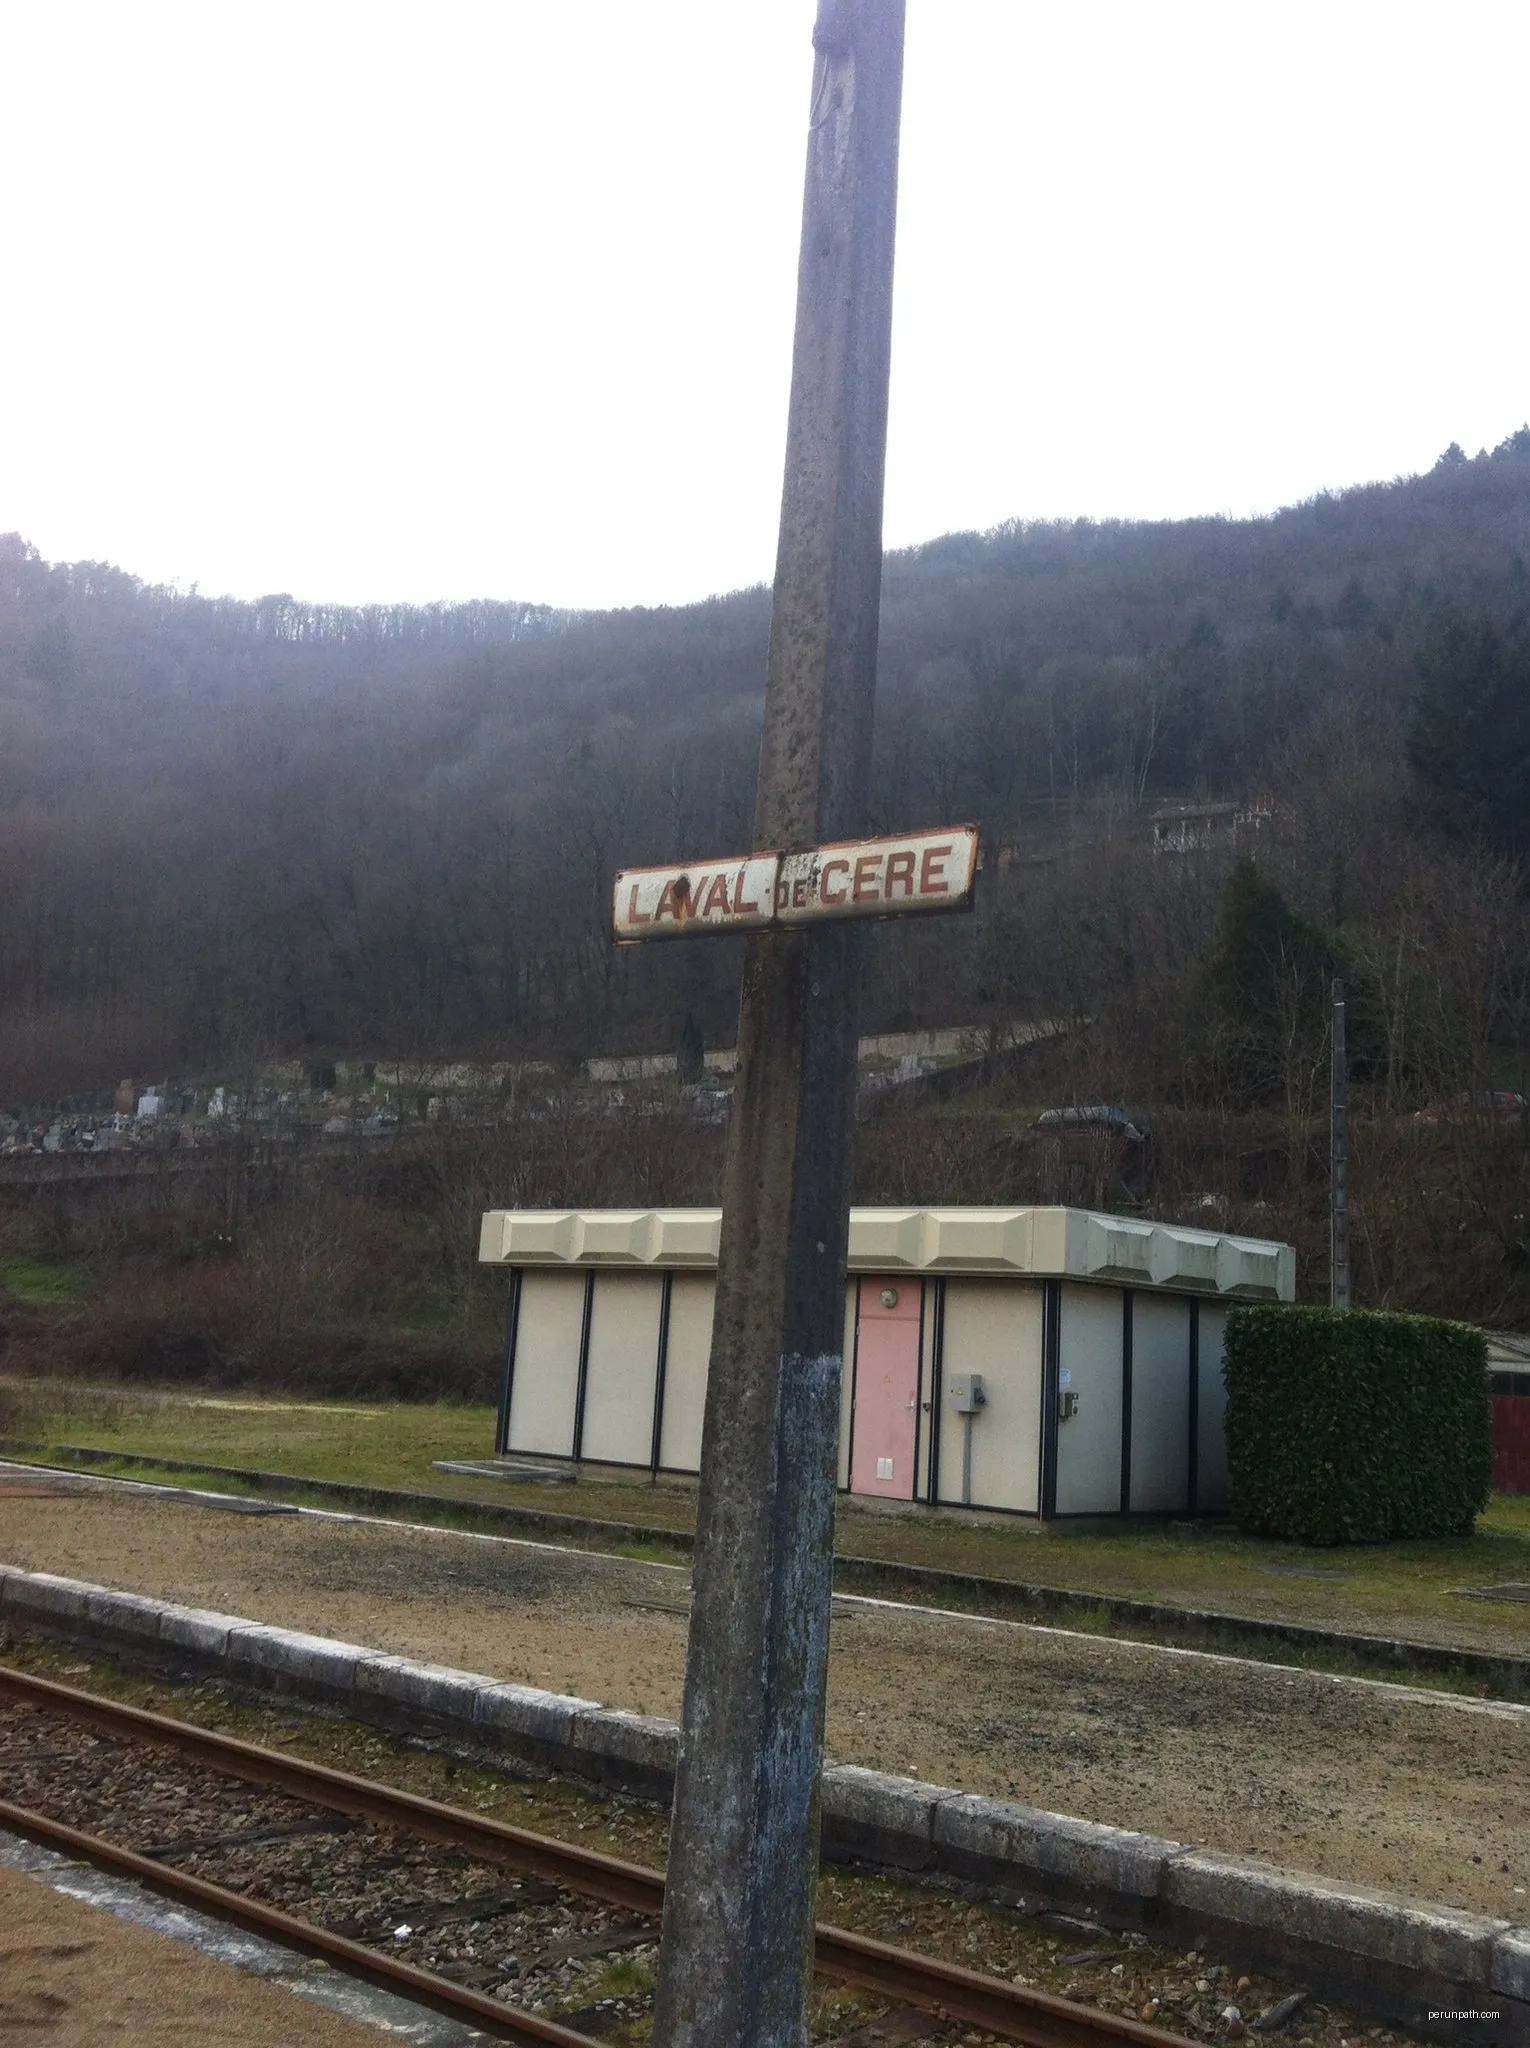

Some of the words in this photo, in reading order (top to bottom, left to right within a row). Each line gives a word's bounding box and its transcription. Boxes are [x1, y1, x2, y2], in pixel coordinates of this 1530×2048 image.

[628, 871, 759, 924] LAVAL
[775, 878, 808, 910] DE
[820, 845, 953, 904] CERE
